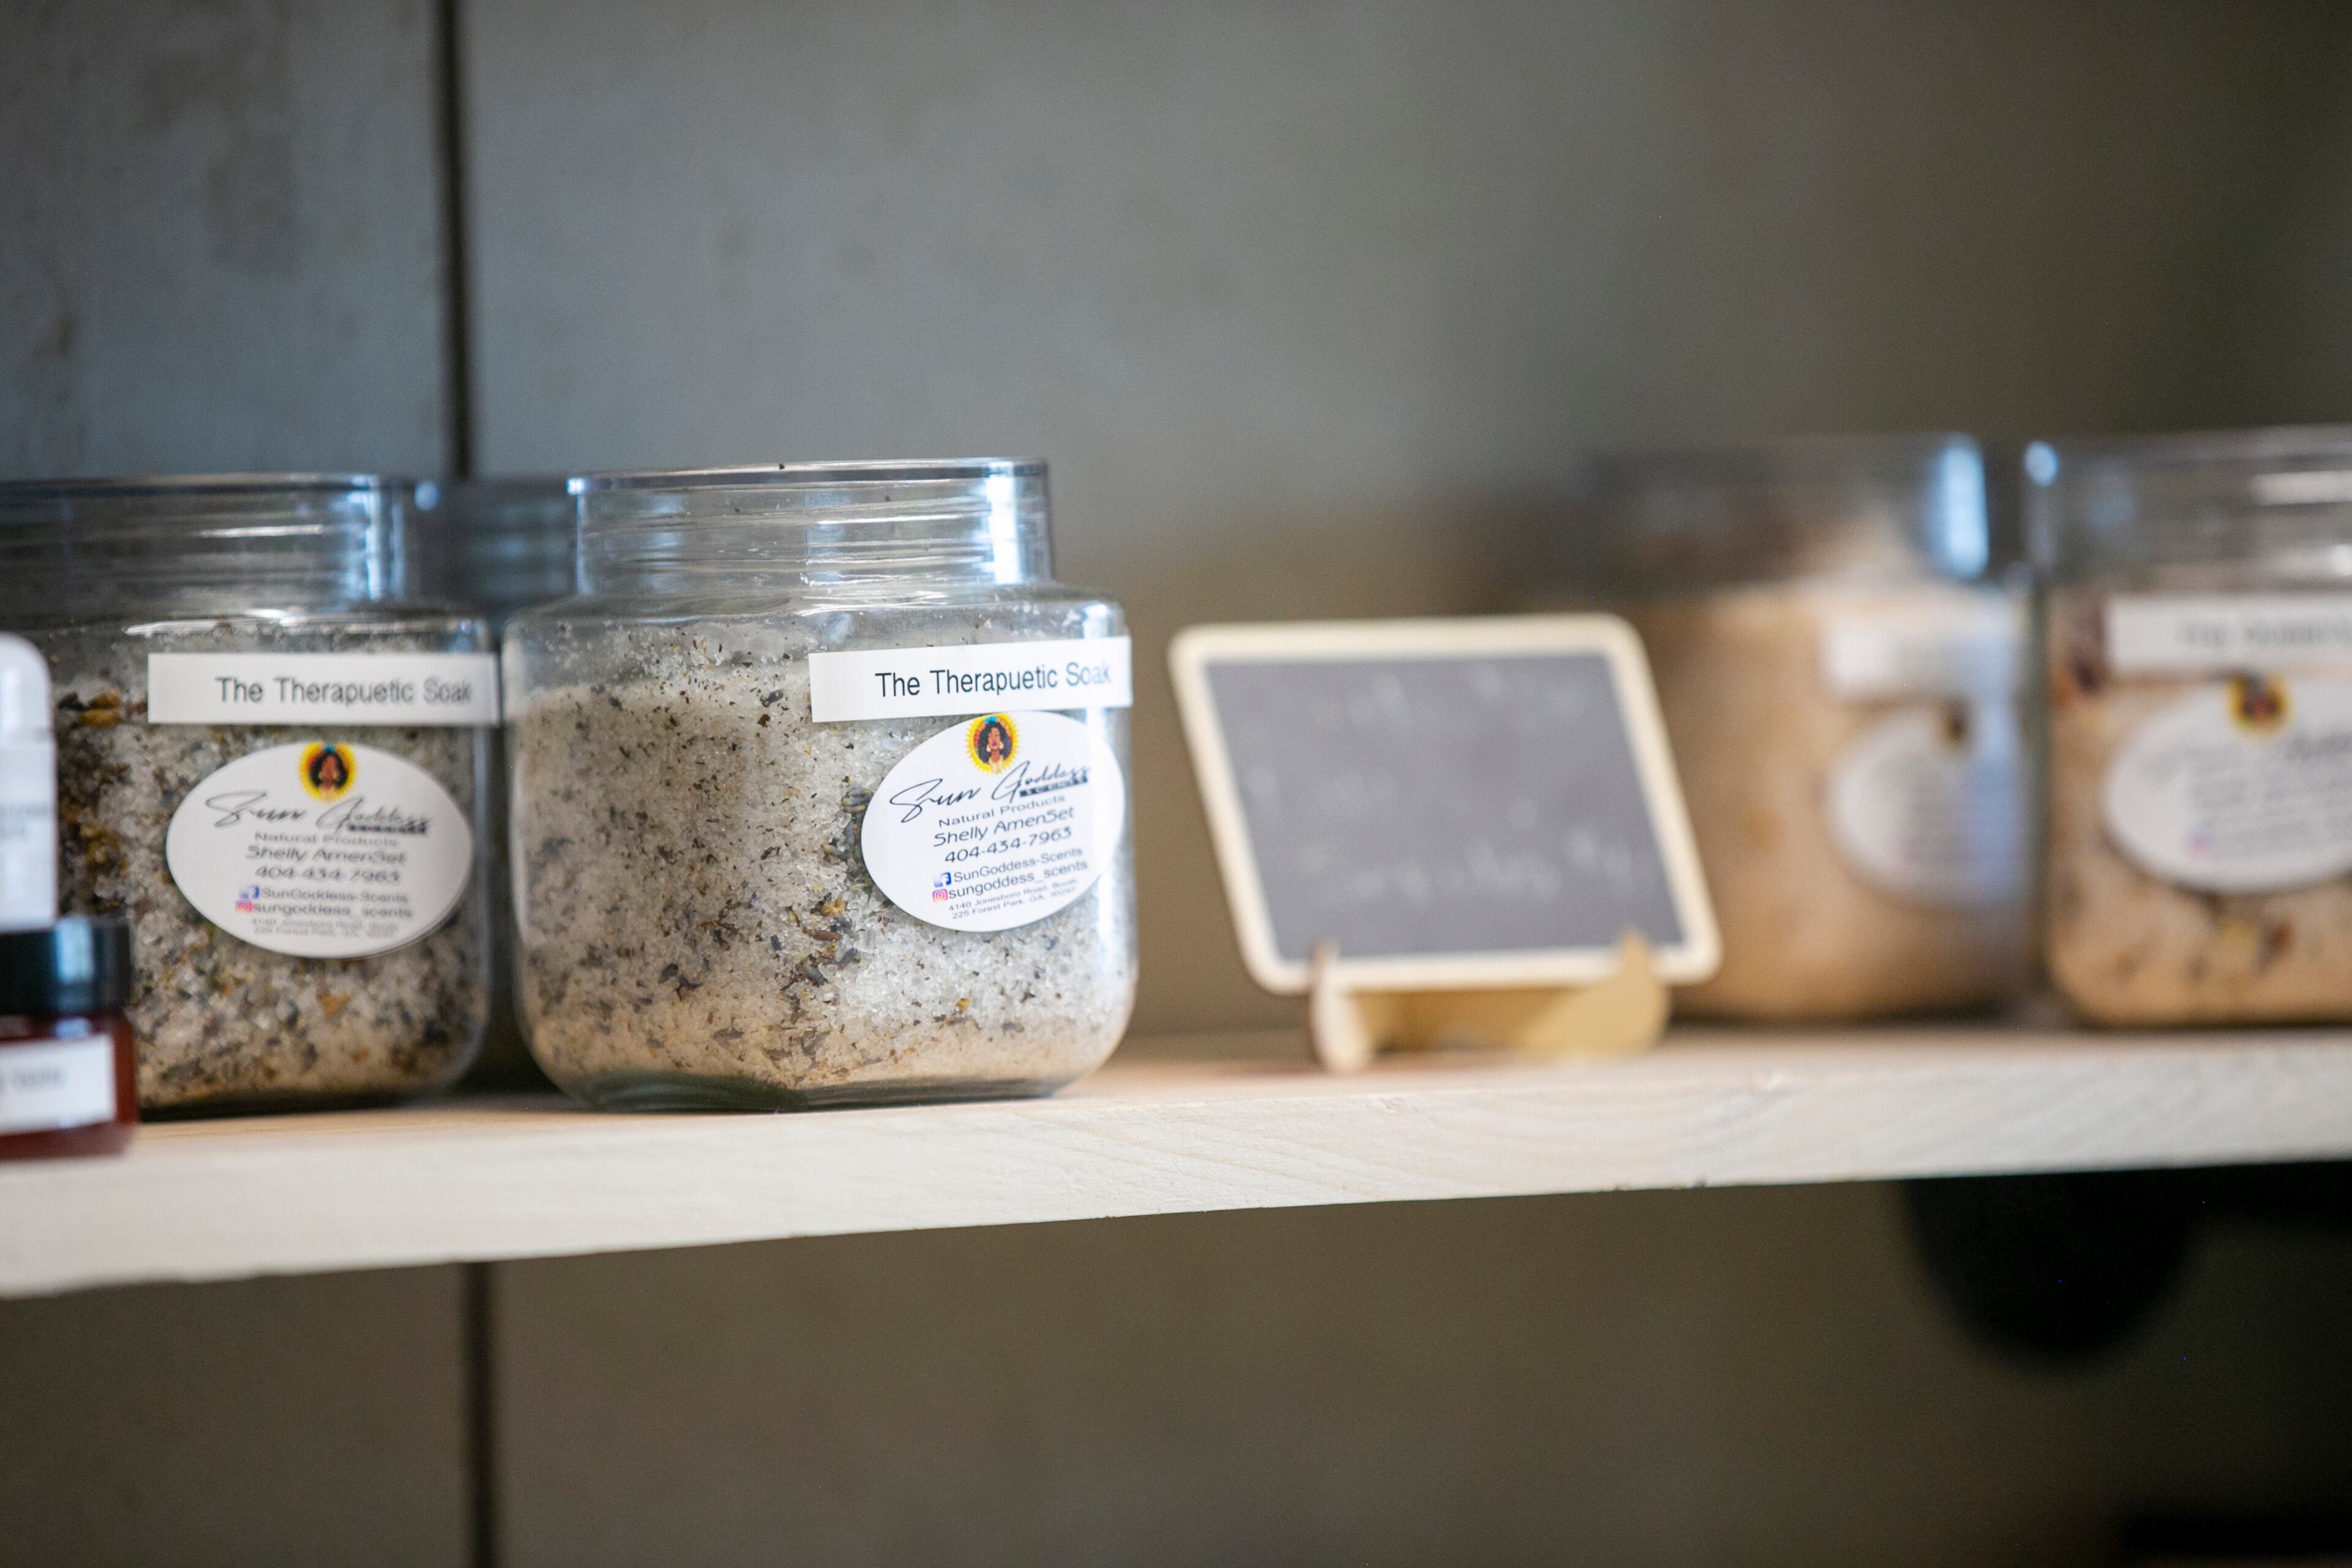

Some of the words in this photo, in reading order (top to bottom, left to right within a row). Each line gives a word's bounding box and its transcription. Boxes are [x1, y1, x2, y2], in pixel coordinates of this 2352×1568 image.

[215, 677, 263, 703] The
[274, 677, 414, 706] Therapuetic
[423, 676, 472, 703] Soak
[875, 673, 920, 697] The
[930, 664, 1057, 695] Therapuetic
[1066, 662, 1111, 687] Soak
[205, 791, 306, 827] Sun
[889, 778, 981, 823] Sun
[991, 761, 1090, 804] Goddess
[933, 826, 988, 846] Shelly
[994, 807, 1074, 835] AmenSet
[939, 808, 994, 827] Natural
[1000, 794, 1065, 814] Products
[246, 846, 307, 863] Shelly
[254, 832, 316, 844] Natural
[323, 833, 397, 847] Products
[945, 826, 1072, 864] 404-434-7963
[949, 861, 1088, 899] sungoddess_scents
[954, 847, 1082, 883] SunGoddess-Scents
[949, 901, 971, 911] 4140
[974, 892, 1020, 907] Jonesboro
[952, 911, 970, 919] 225
[973, 903, 1001, 916] Forest
